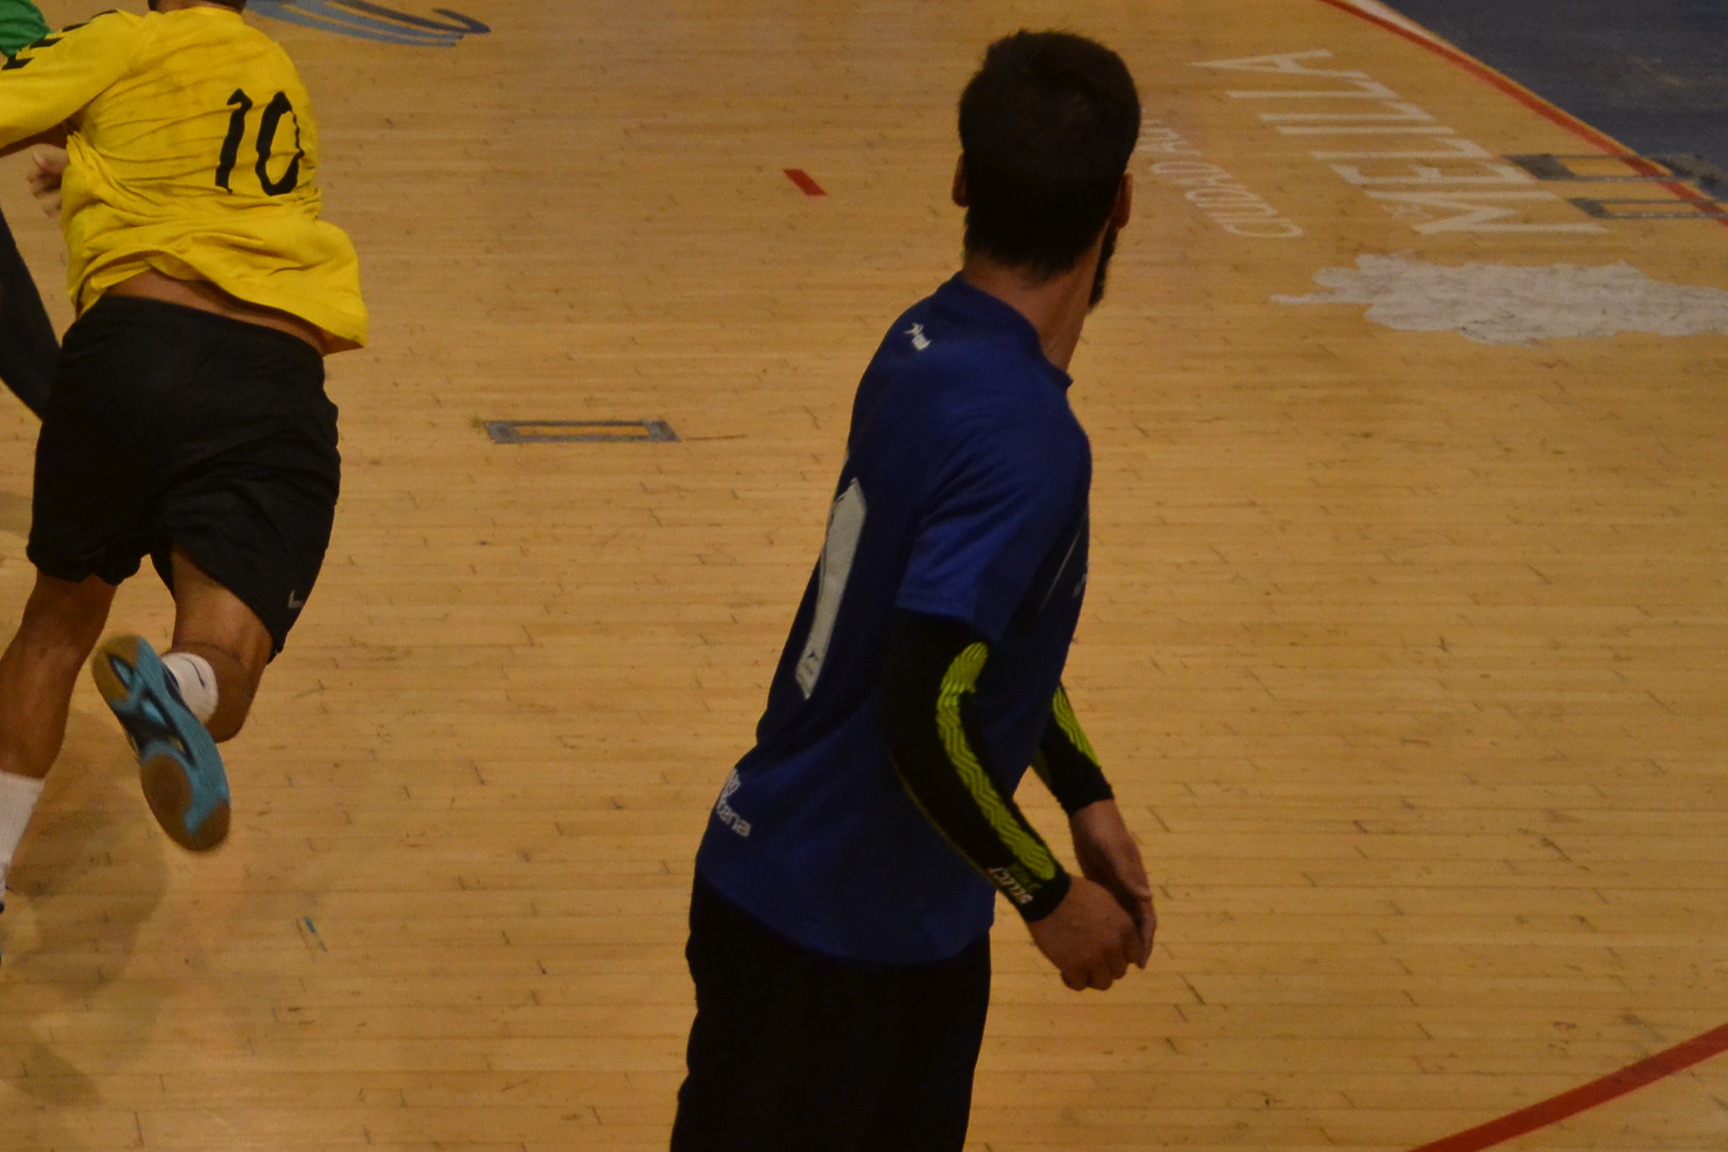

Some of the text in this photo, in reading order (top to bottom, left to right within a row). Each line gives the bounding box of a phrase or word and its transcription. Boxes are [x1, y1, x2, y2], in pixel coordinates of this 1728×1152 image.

[214, 87, 307, 198] 10
[1188, 48, 1608, 235] MELILLA
[1149, 160, 1304, 238] CIUDAD
